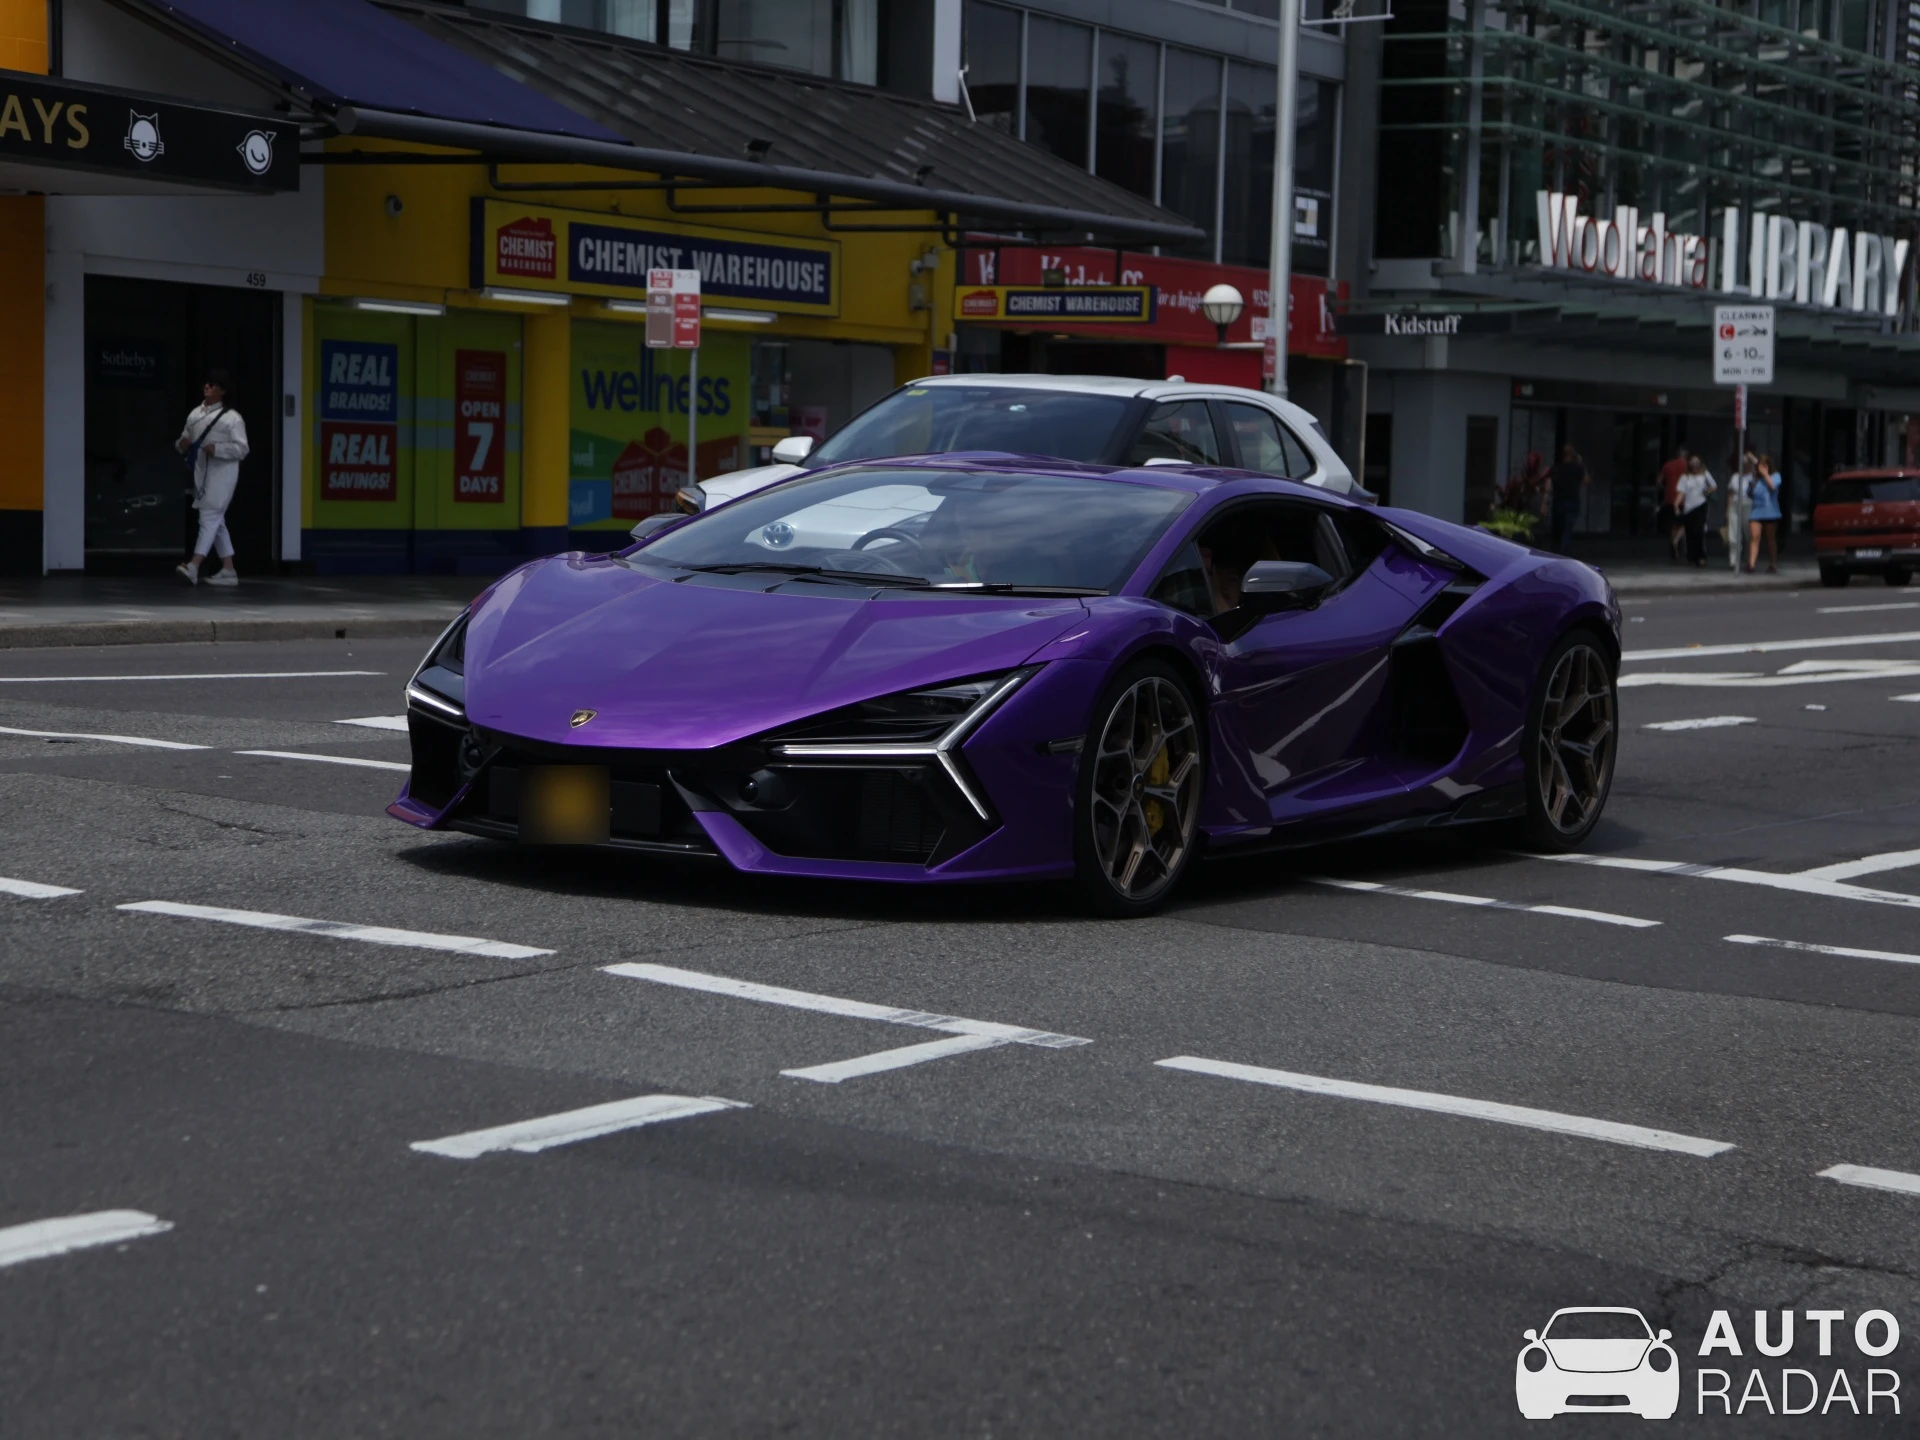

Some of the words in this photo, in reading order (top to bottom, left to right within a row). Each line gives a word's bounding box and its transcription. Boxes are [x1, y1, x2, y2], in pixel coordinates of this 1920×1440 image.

[500, 236, 554, 260] CHEMIST
[1536, 190, 1707, 288] Woollahra
[1722, 206, 1909, 316] LIBRARY
[578, 237, 683, 275] CHEMIST
[691, 250, 825, 293] WAREHOUSE
[246, 272, 266, 287] 459
[1009, 295, 1061, 311] CHEMIST
[1065, 296, 1139, 312] WAREHOUSE
[1384, 313, 1462, 335] Kidstuff
[1720, 311, 1771, 321] CLEARWAY
[101, 349, 156, 370] Sotheby's
[329, 352, 391, 387] REAL
[582, 343, 731, 417] wellness
[328, 391, 391, 412] BRANDS!
[461, 401, 500, 419] OPEN
[328, 432, 391, 466] REAL
[468, 421, 494, 472] 7
[328, 471, 391, 490] SAVINGS!
[459, 475, 499, 494] DAYS
